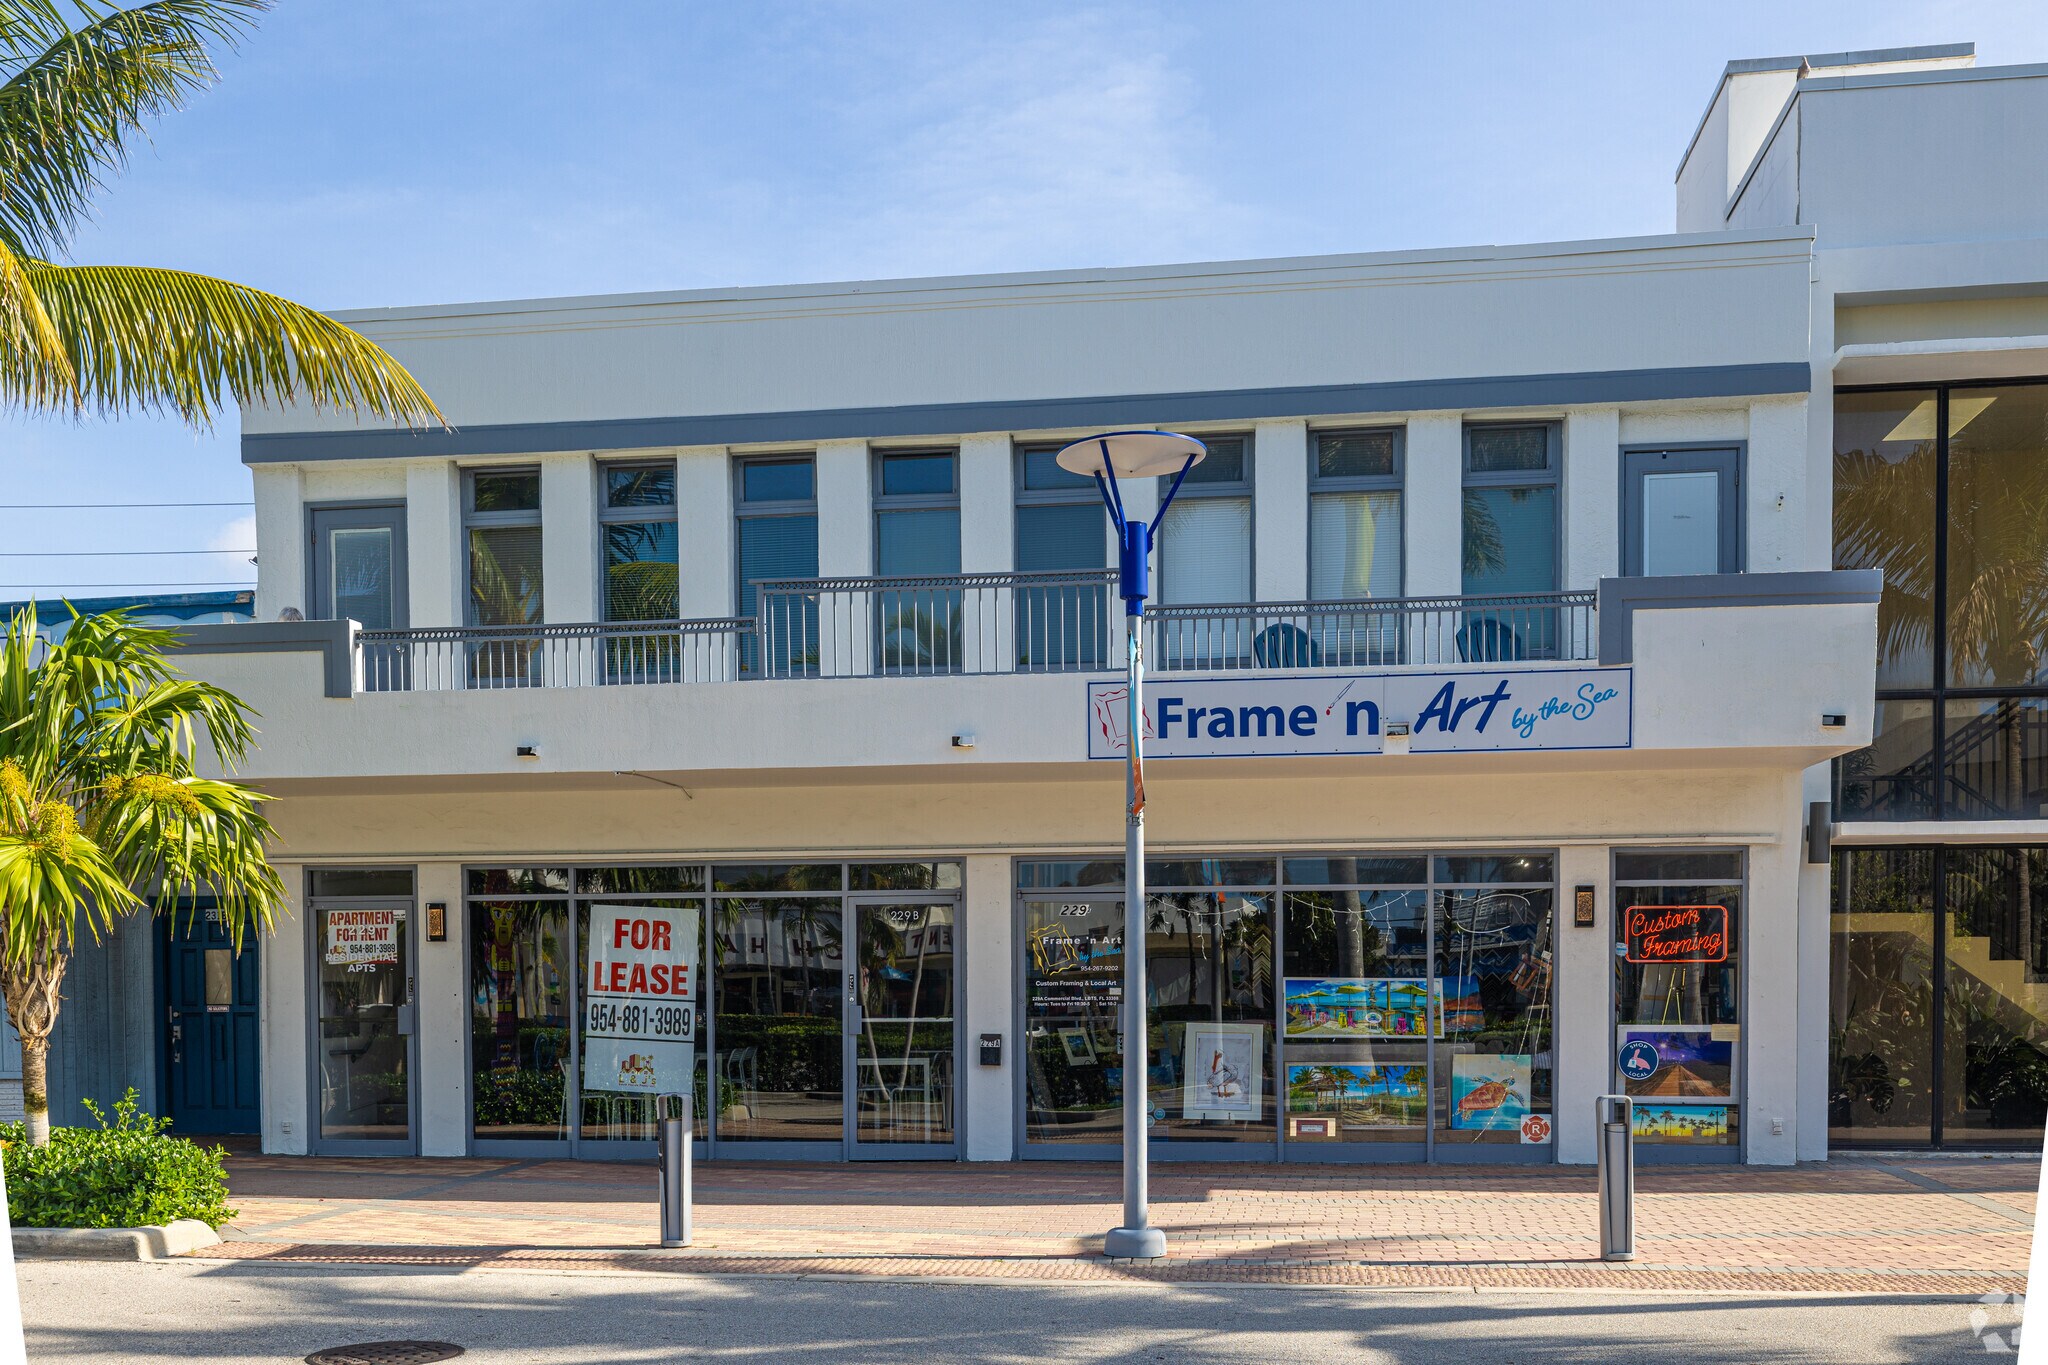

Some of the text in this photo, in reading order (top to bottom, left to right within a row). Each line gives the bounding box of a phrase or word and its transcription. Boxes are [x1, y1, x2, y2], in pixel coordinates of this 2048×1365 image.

[1157, 697, 1317, 739] Frame
[1414, 679, 1511, 734] Art
[1512, 708, 1537, 739] by
[1539, 697, 1572, 721] the
[1574, 683, 1618, 721] Sea
[1061, 905, 1087, 916] 229
[329, 911, 394, 926] APARTMENT
[1630, 908, 1701, 937] Custom
[613, 918, 672, 951] FOR
[1042, 936, 1081, 945] Frame
[1102, 936, 1122, 945] Art
[1640, 931, 1723, 959] Framing
[350, 943, 395, 954] 954-881-3989
[325, 953, 398, 962] RESIDENTIAL
[1079, 952, 1090, 963] by
[1091, 948, 1104, 959] the
[347, 963, 376, 973] APTS
[593, 961, 689, 996] LEASE
[590, 1003, 691, 1036] 954-881-3989
[1629, 1042, 1649, 1050] SHOP
[629, 1074, 637, 1083] &
[1628, 1070, 1649, 1078] LOCAL
[1531, 1124, 1540, 1134] R
